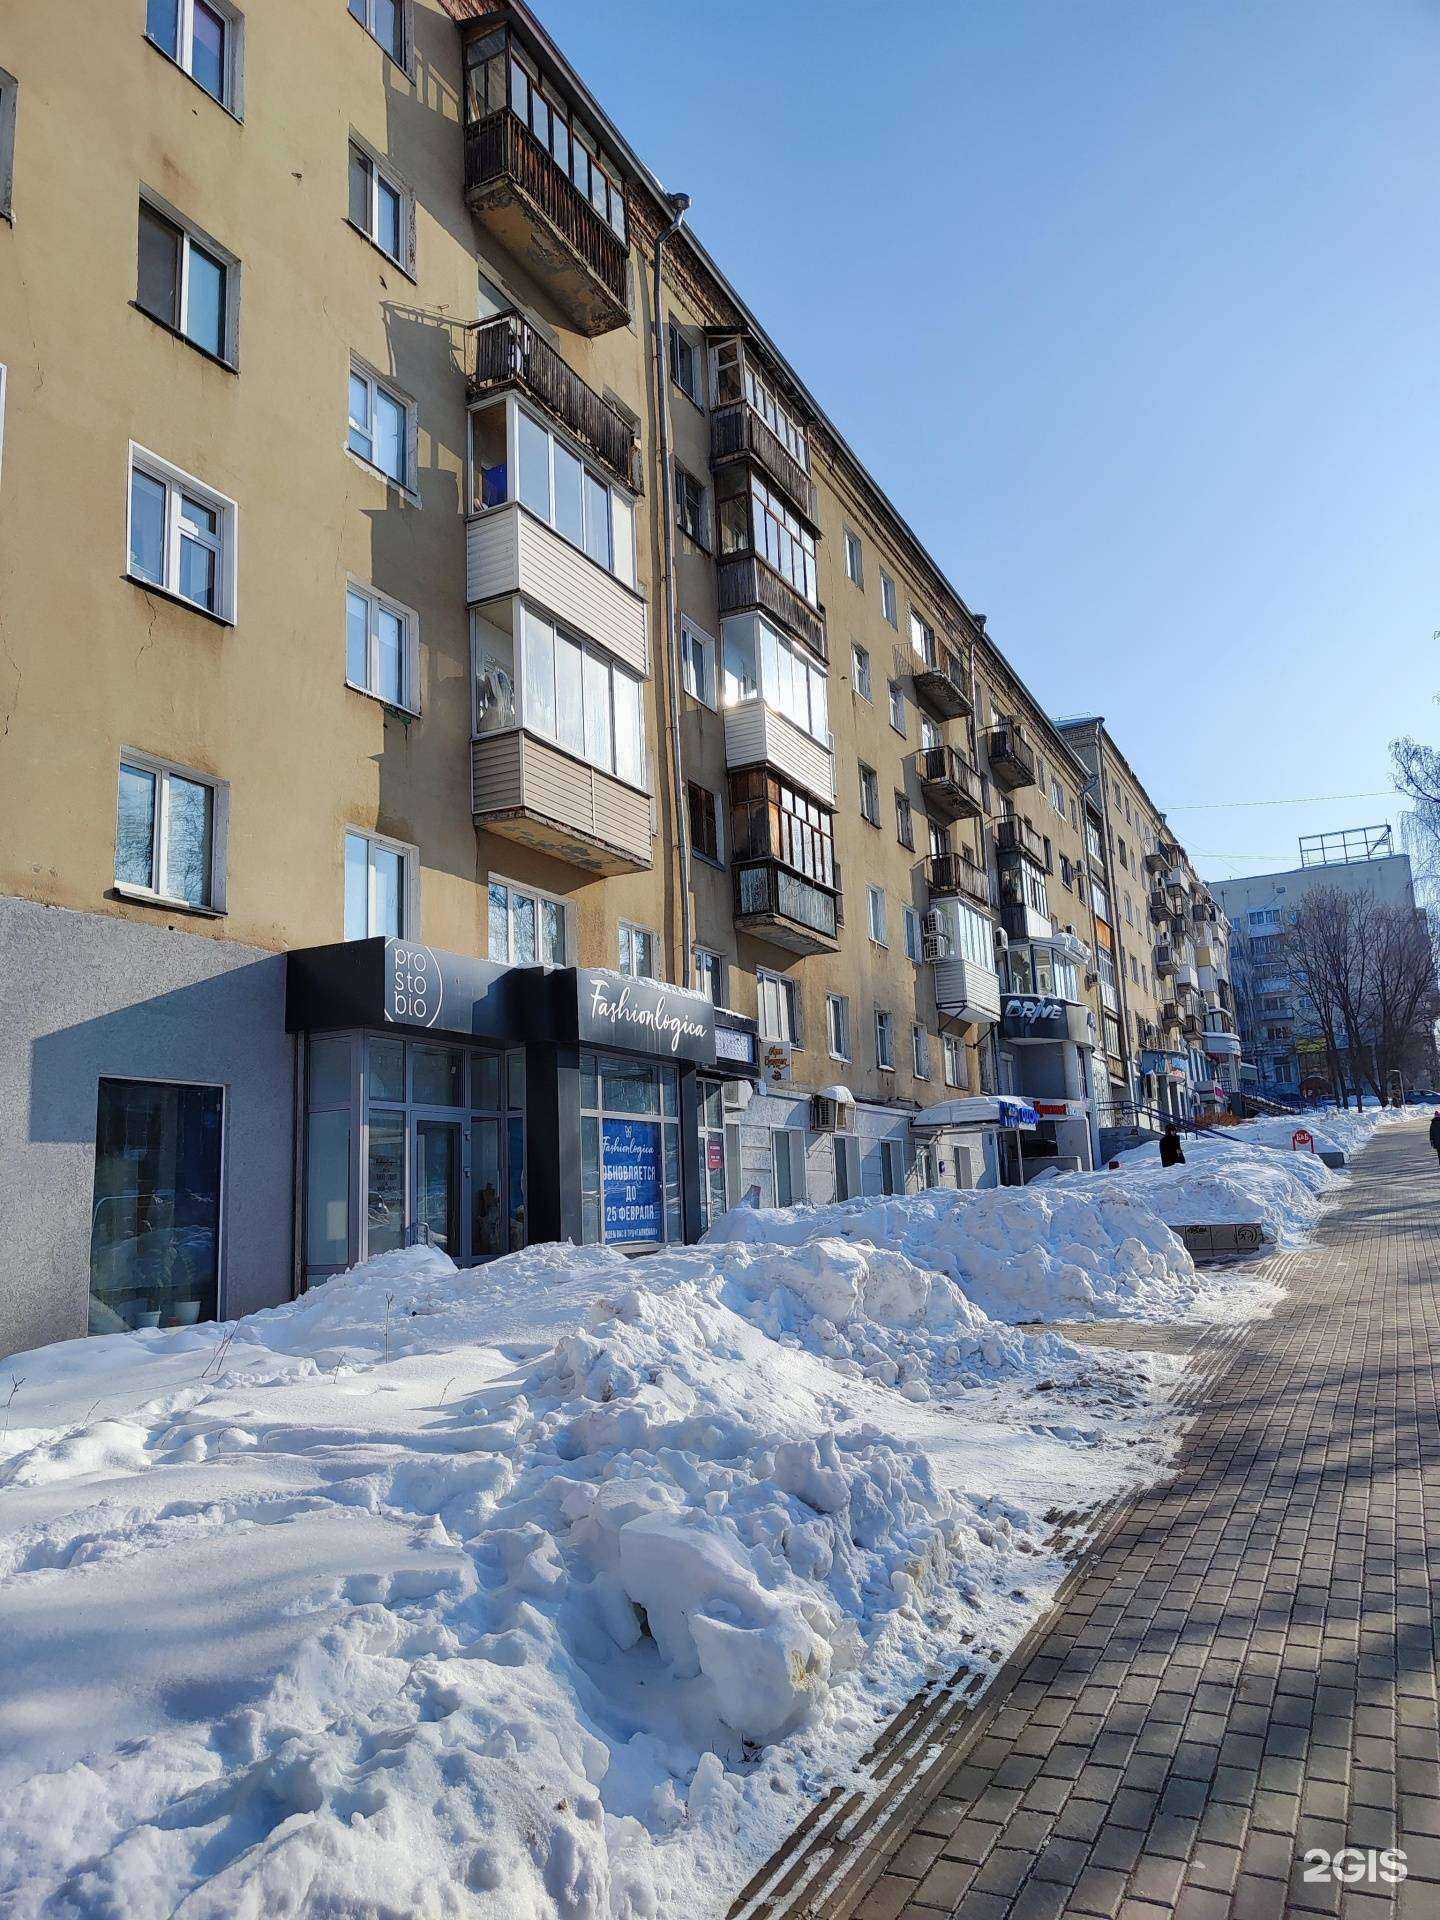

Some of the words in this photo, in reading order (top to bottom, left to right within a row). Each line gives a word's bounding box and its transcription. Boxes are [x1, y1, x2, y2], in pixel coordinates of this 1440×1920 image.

[394, 947, 427, 972] pro
[394, 971, 427, 995] sto
[393, 990, 427, 1018] bio
[589, 978, 708, 1052] Fashionlogica
[625, 1185, 637, 1202] ДО
[606, 1206, 617, 1222] 25
[618, 1205, 654, 1221] ФЕВРАЛЯ
